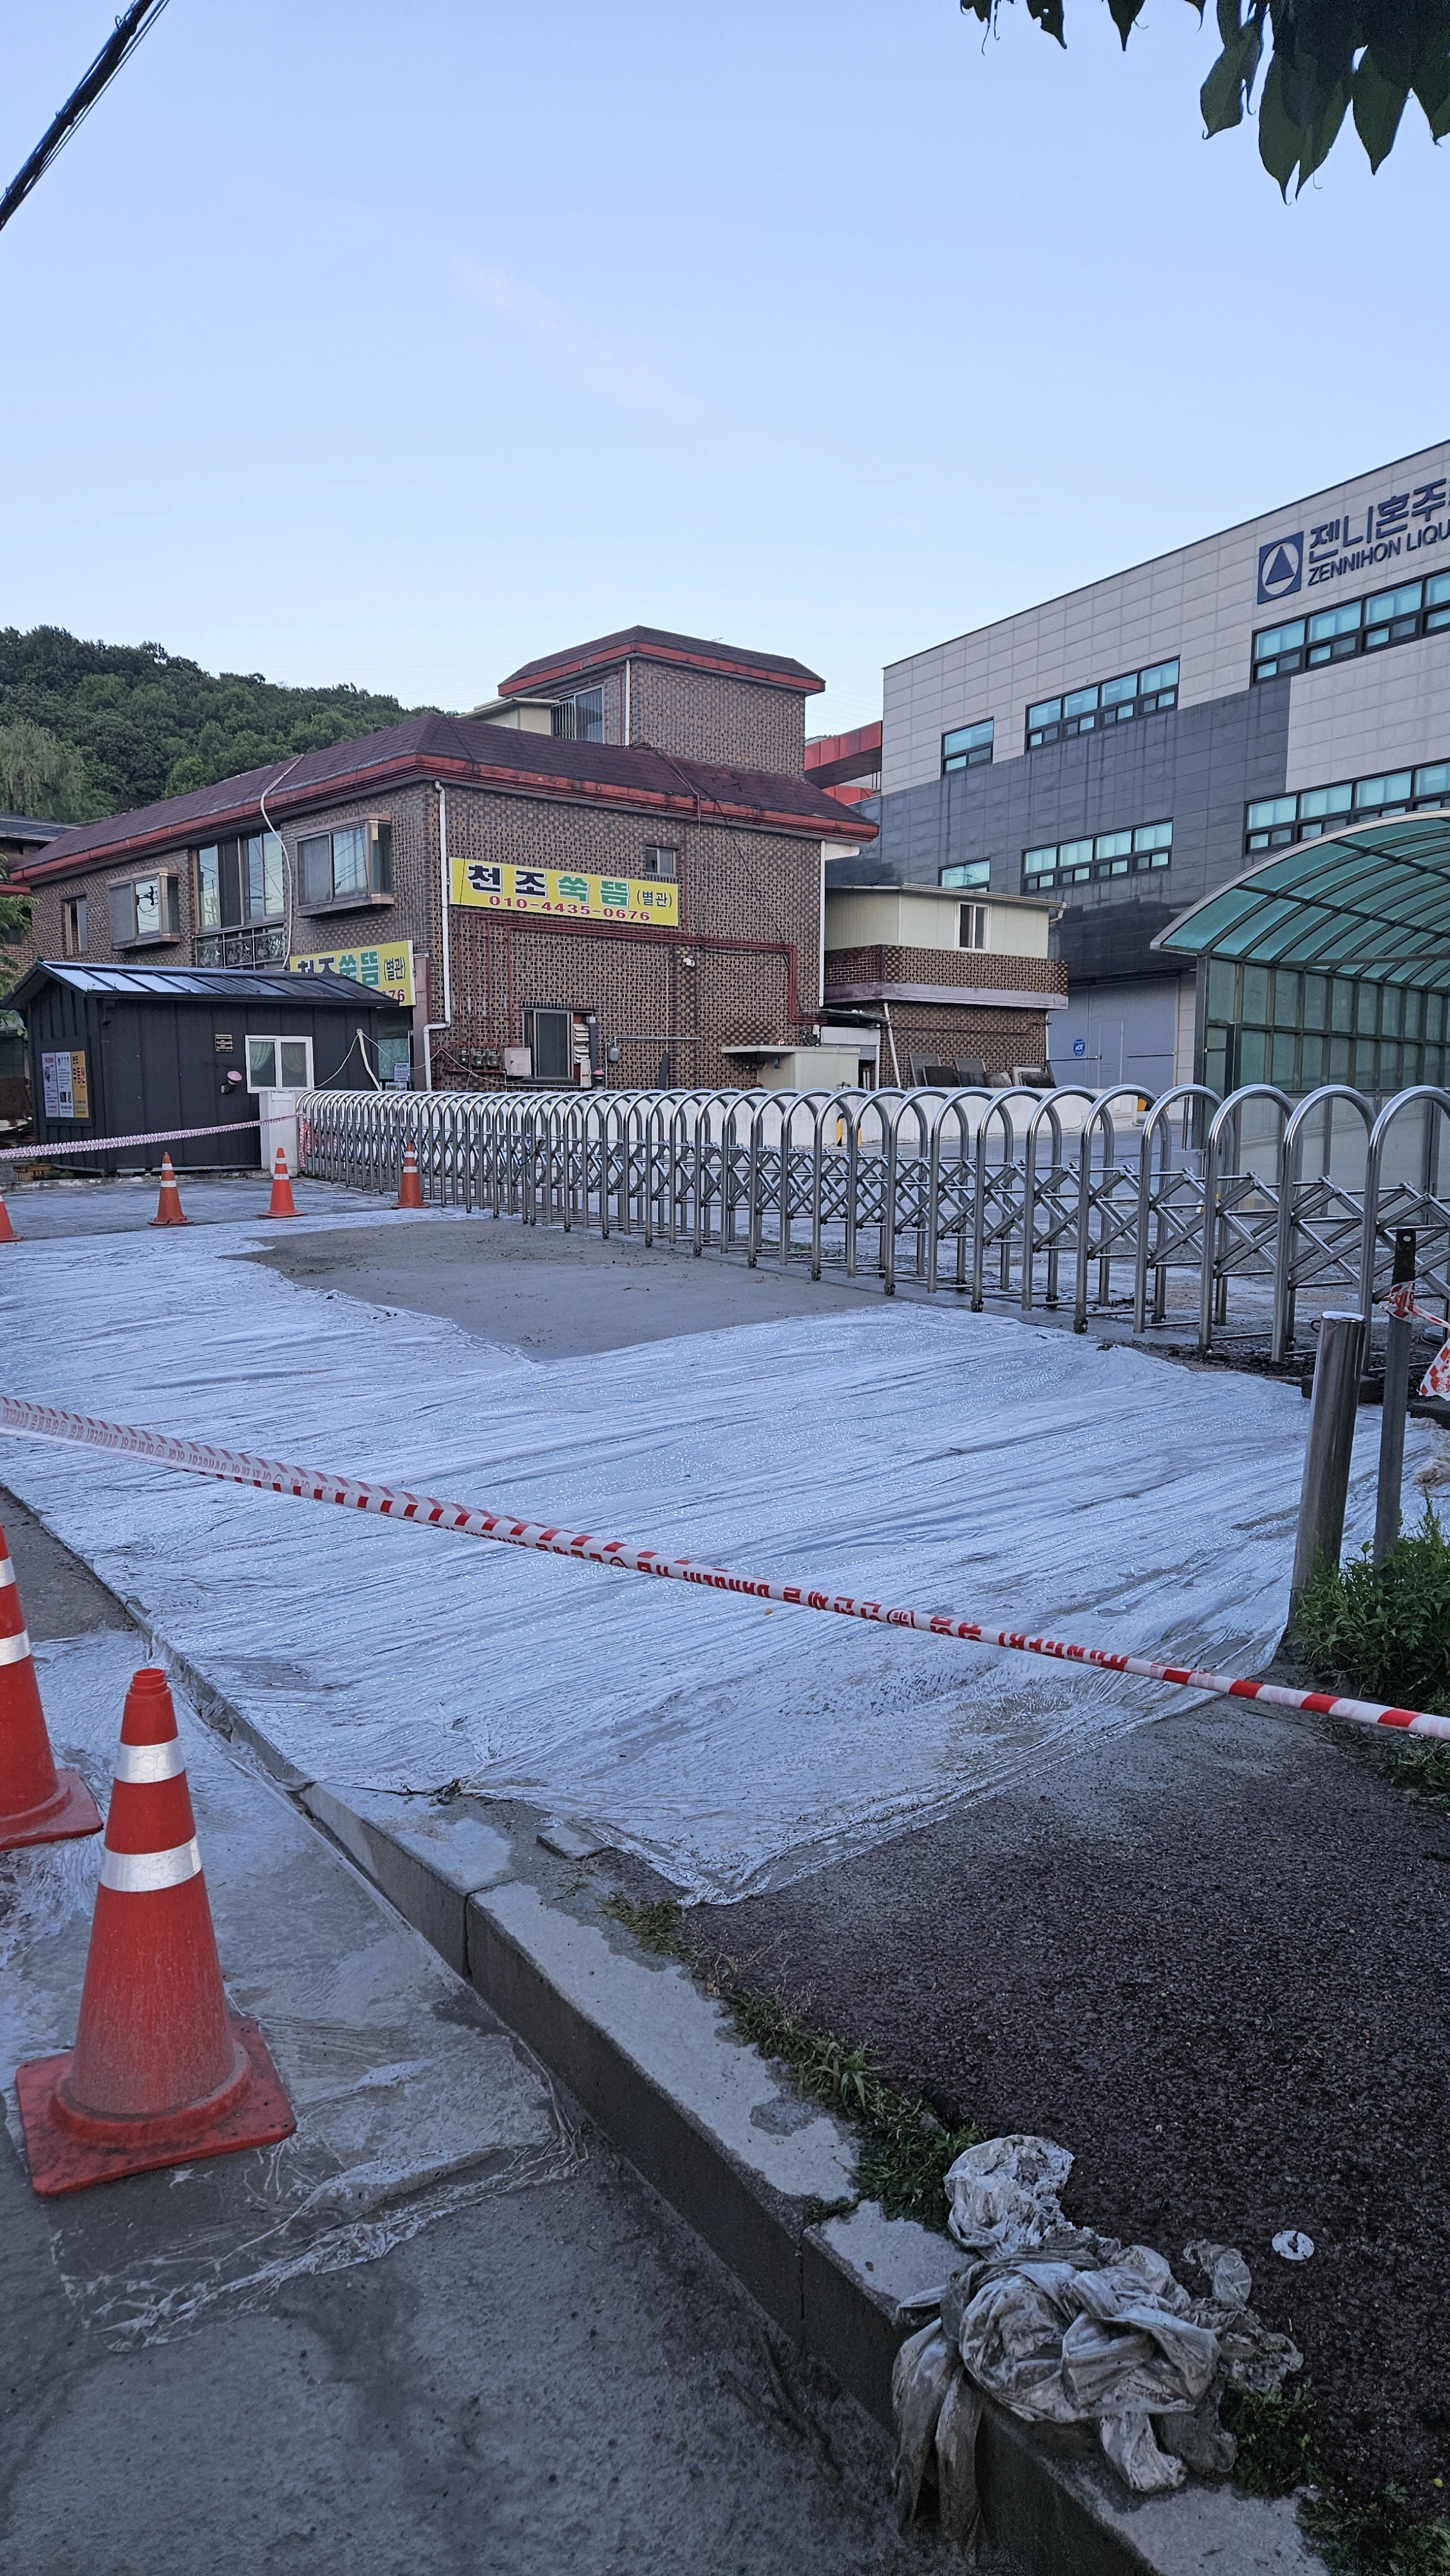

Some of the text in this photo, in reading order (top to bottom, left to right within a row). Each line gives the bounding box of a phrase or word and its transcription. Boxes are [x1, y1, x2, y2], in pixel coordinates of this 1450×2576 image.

[1309, 478, 1450, 564] 젠니혼주
[1308, 536, 1401, 586] ZENNIHON
[489, 895, 650, 921] 010-4435-0676
[637, 889, 673, 908] (별관)
[384, 956, 406, 981] (별관)
